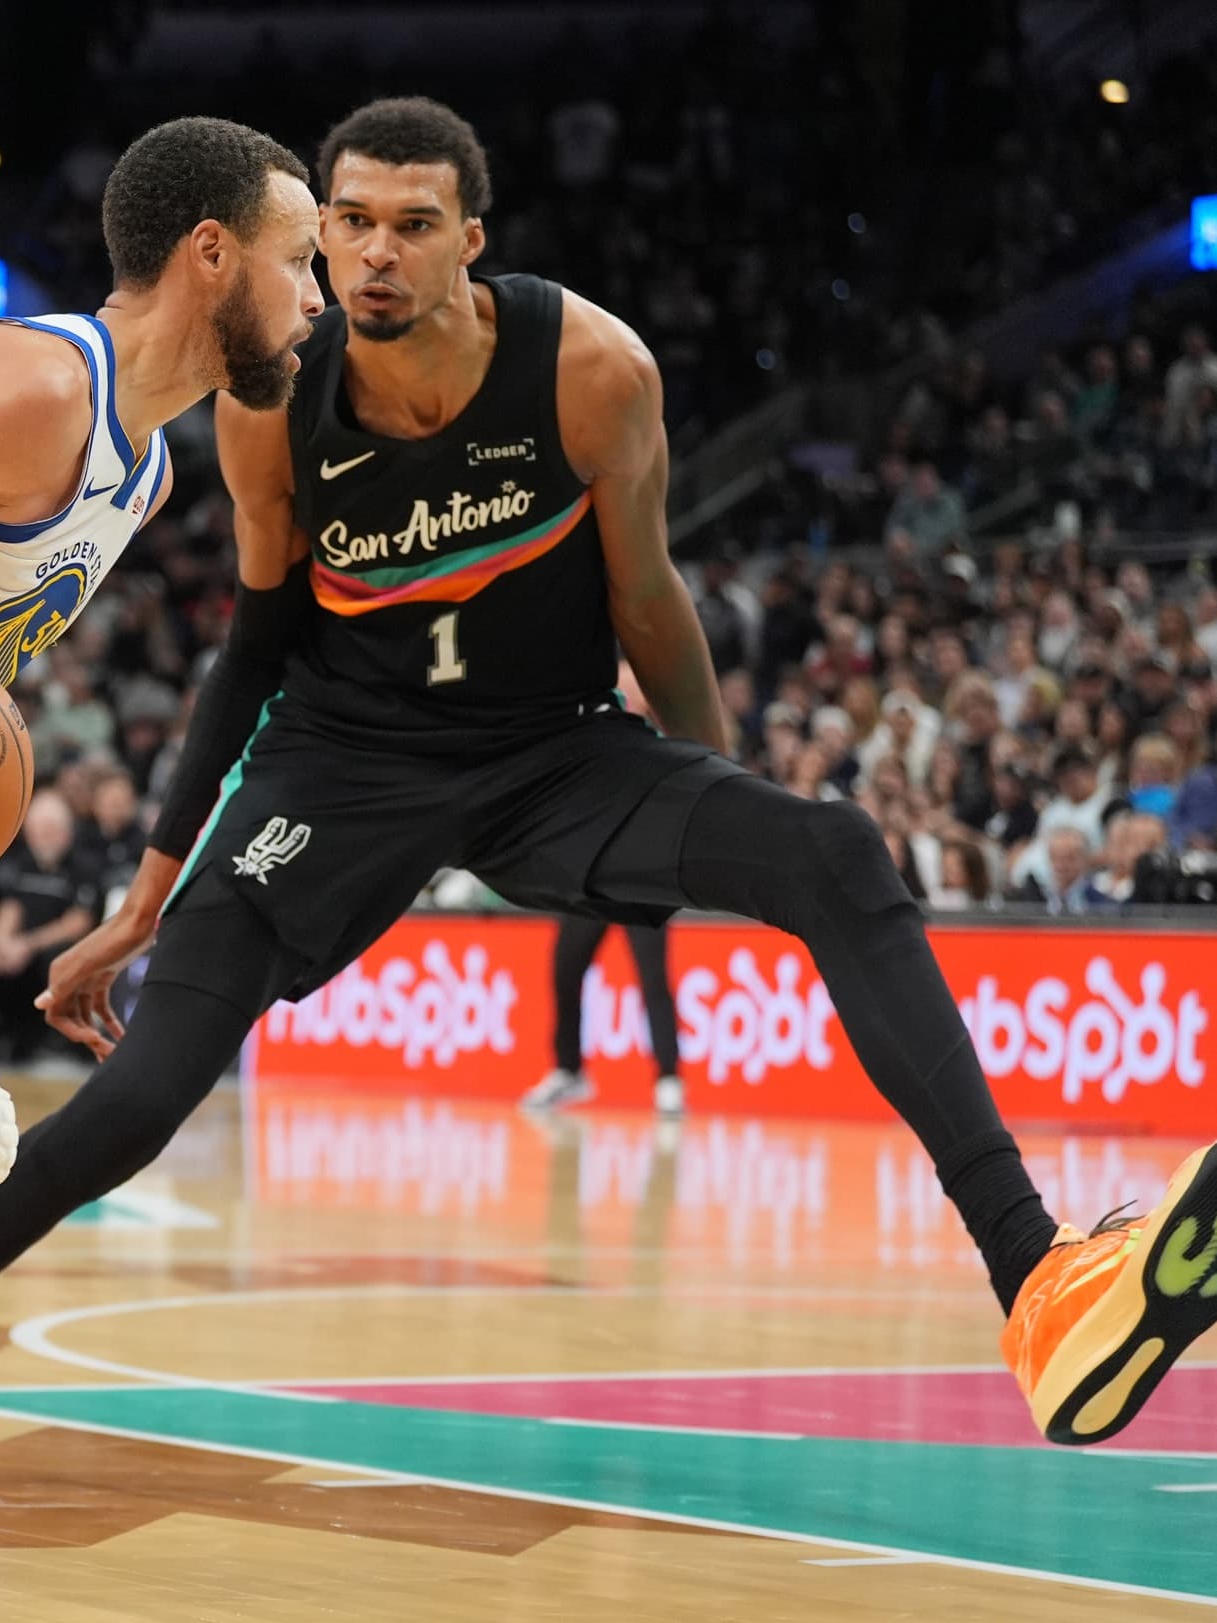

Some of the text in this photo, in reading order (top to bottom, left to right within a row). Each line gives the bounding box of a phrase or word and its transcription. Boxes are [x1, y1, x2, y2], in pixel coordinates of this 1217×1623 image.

[474, 443, 528, 461] LEDGER
[320, 480, 536, 568] San Antonio
[36, 541, 97, 579] GOLDEN
[21, 610, 67, 659] 30
[426, 610, 467, 687] 1
[958, 955, 1209, 1104] bSpot
